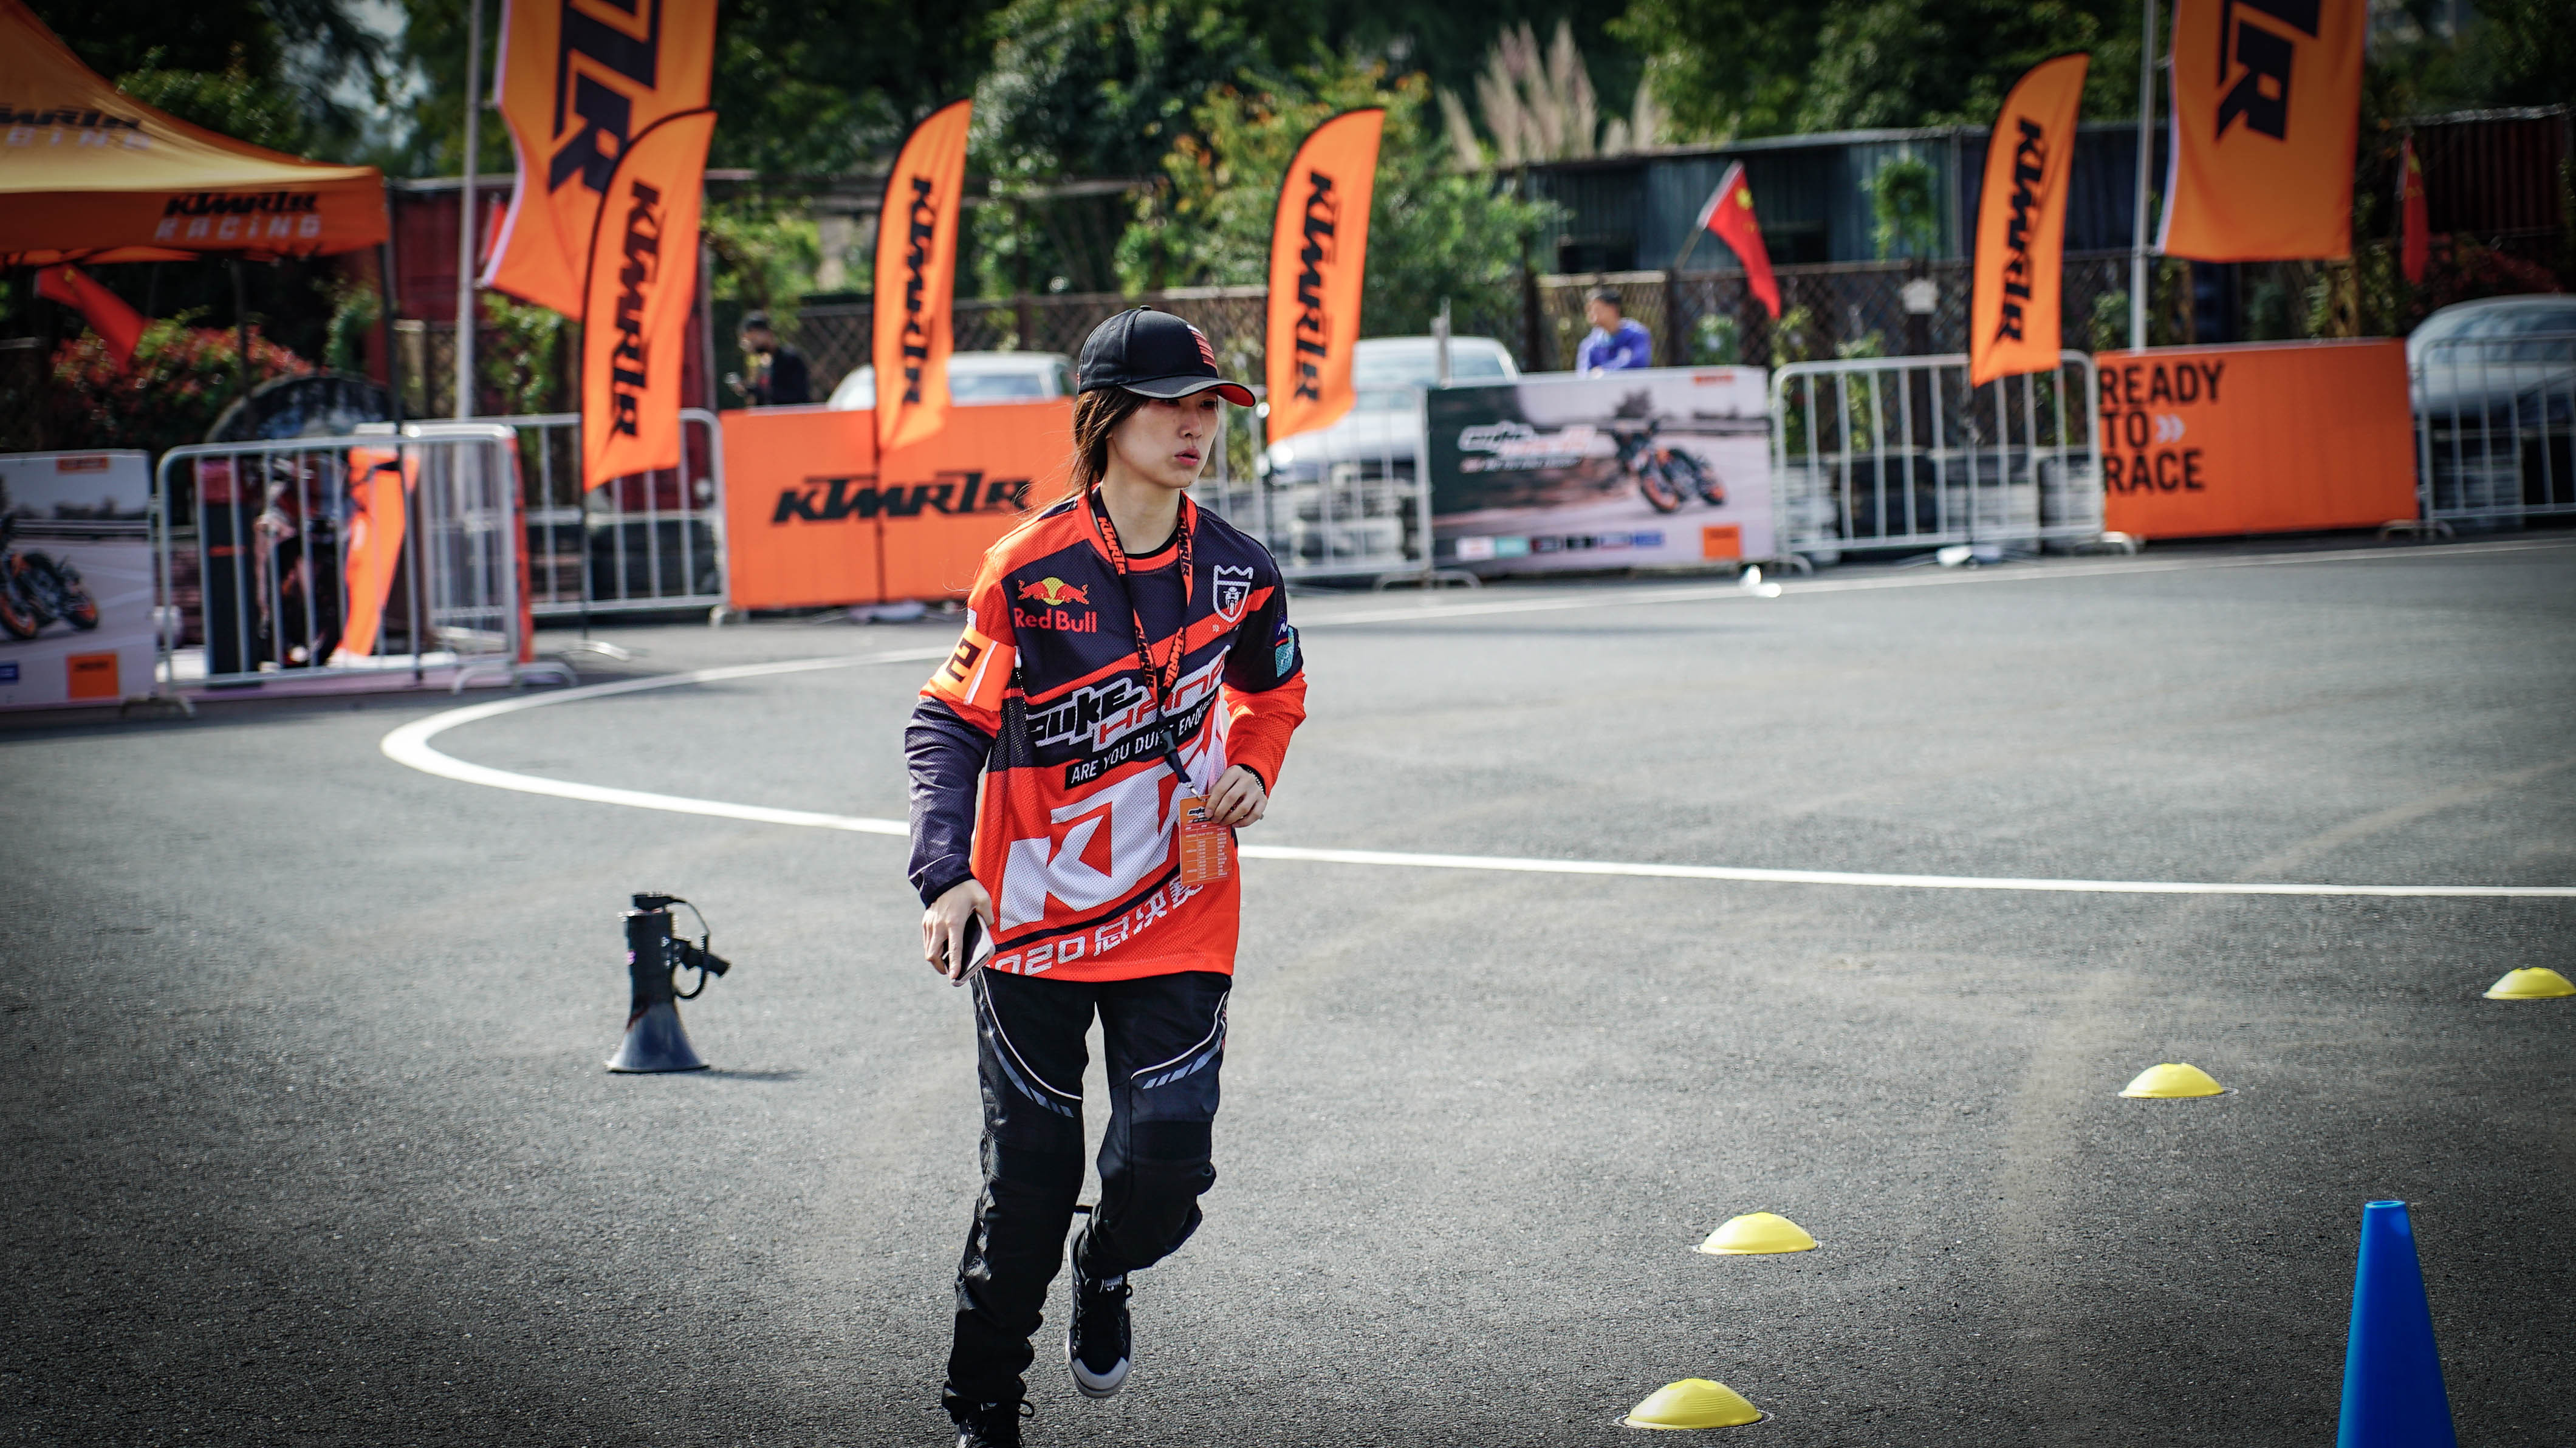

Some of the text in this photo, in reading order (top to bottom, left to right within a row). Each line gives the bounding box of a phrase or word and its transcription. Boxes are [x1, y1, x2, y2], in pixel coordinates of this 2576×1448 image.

[2099, 361, 2225, 405] READY
[2100, 409, 2149, 449] TO
[2104, 449, 2205, 494] RACE
[1014, 607, 1097, 632] Red Bull
[1071, 760, 1098, 784] ARE
[1103, 742, 1129, 769] YOU
[1135, 723, 1174, 754] DUK
